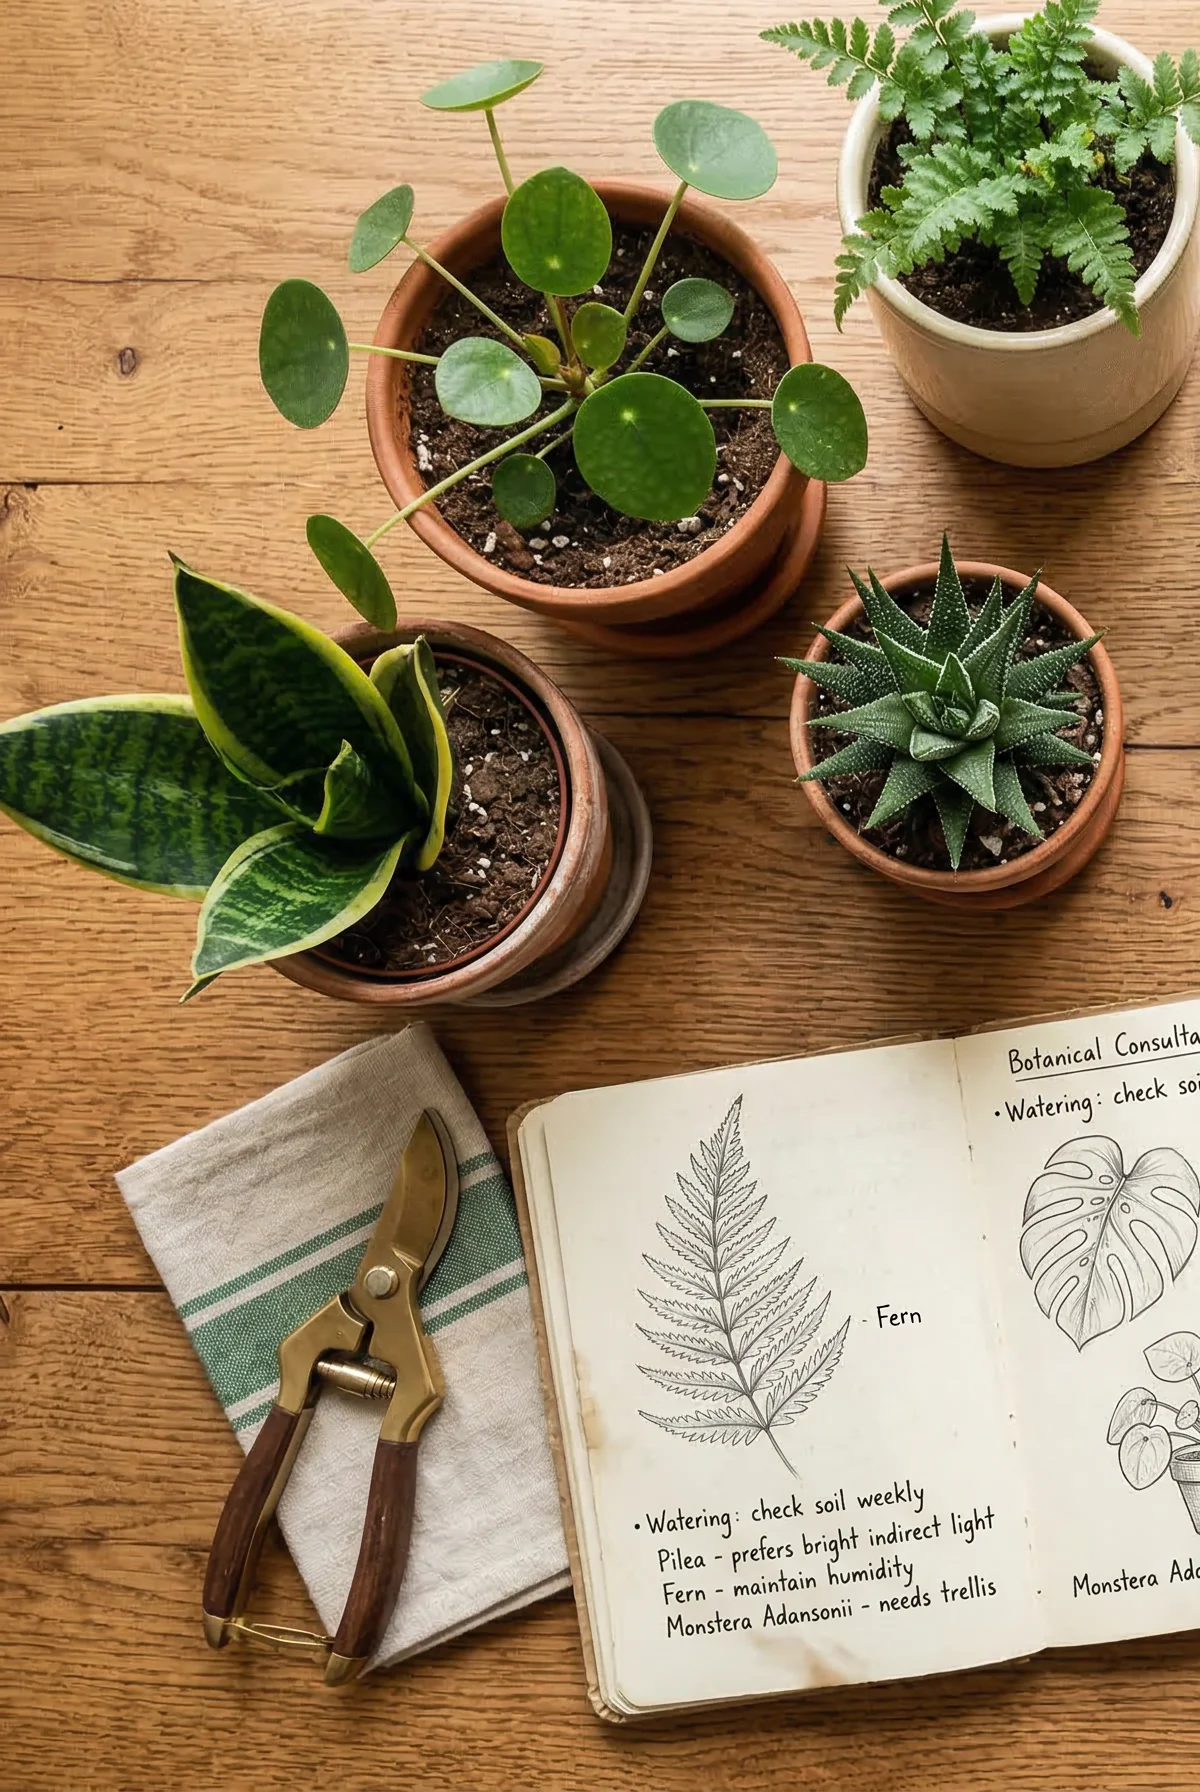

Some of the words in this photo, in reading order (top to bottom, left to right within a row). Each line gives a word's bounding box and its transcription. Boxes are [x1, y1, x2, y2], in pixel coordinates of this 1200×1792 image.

[1008, 1036, 1102, 1075] Botanical
[1004, 1093, 1102, 1124] Watering:
[1113, 1077, 1168, 1105] check
[876, 1304, 922, 1329] Fern
[645, 1507, 741, 1540] Watering:
[751, 1495, 804, 1522] check
[815, 1488, 847, 1515] soil
[856, 1479, 925, 1514] weekly
[657, 1547, 706, 1573] Pilea
[731, 1535, 794, 1574] prefers
[801, 1526, 859, 1564] bright
[868, 1514, 942, 1547] indirect
[950, 1505, 995, 1544] light
[662, 1581, 706, 1606] Fern
[733, 1569, 817, 1597] maintain
[826, 1554, 914, 1588] humidity
[1073, 1568, 1159, 1598] Monstera
[667, 1610, 753, 1639] Monstera
[762, 1598, 853, 1628] Adansonii
[879, 1584, 932, 1613] needs
[940, 1575, 997, 1604] trellis
